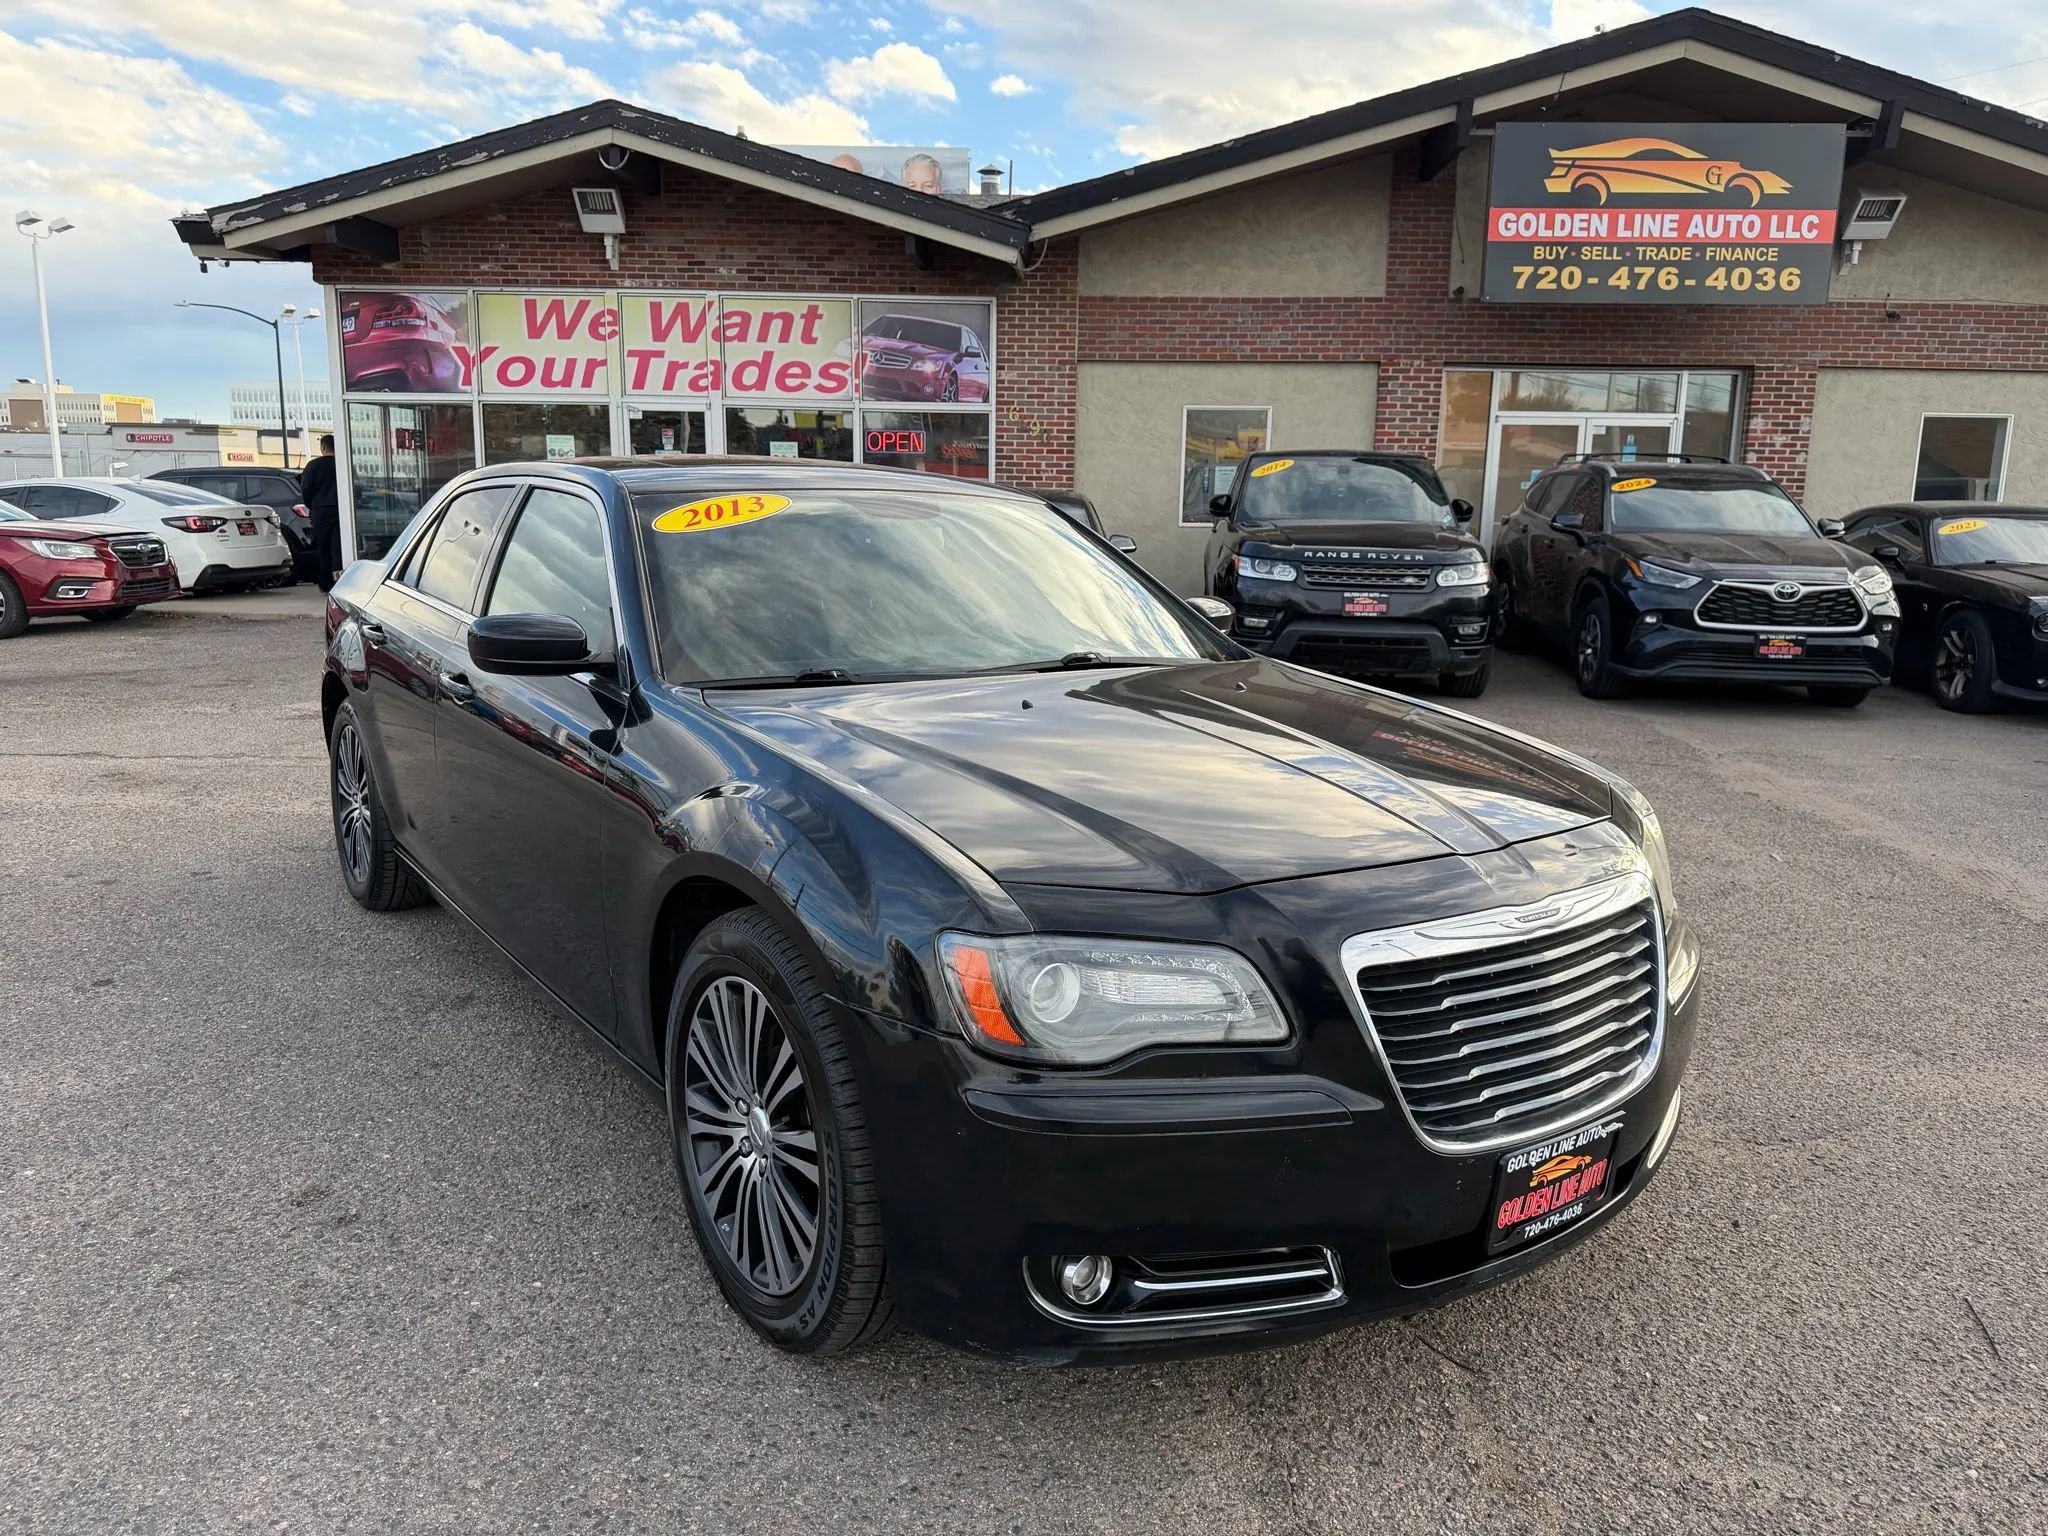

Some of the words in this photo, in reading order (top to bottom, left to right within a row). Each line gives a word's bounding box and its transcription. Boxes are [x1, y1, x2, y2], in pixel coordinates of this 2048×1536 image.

[1497, 212, 1608, 238] GOLDEN
[1617, 213, 1680, 239] LINE
[1685, 214, 1761, 239] AUTO
[1769, 215, 1820, 240] LLC
[1533, 246, 1569, 260] BUY
[1580, 246, 1622, 261] SELL
[1636, 247, 1692, 261] TRADE
[1705, 247, 1779, 261] FINANCE
[523, 298, 619, 341] We
[648, 300, 824, 344] Want
[451, 345, 608, 388] Your
[867, 431, 924, 453] OPEN
[1617, 480, 1651, 489] 2024
[682, 496, 765, 528] 2013
[1949, 521, 1977, 532] 2021
[1367, 552, 1424, 560] ROVER
[1519, 909, 1558, 922] CHRYSLER
[1551, 1136, 1576, 1157] LINE
[1576, 1125, 1602, 1148] AUTO
[1497, 1186, 1553, 1229] GOLDEN
[1551, 1173, 1580, 1209] LINE
[1577, 1159, 1608, 1197] AUTO
[817, 1128, 840, 1299] SCORPION
[1524, 1203, 1583, 1238] 720-476-4036
